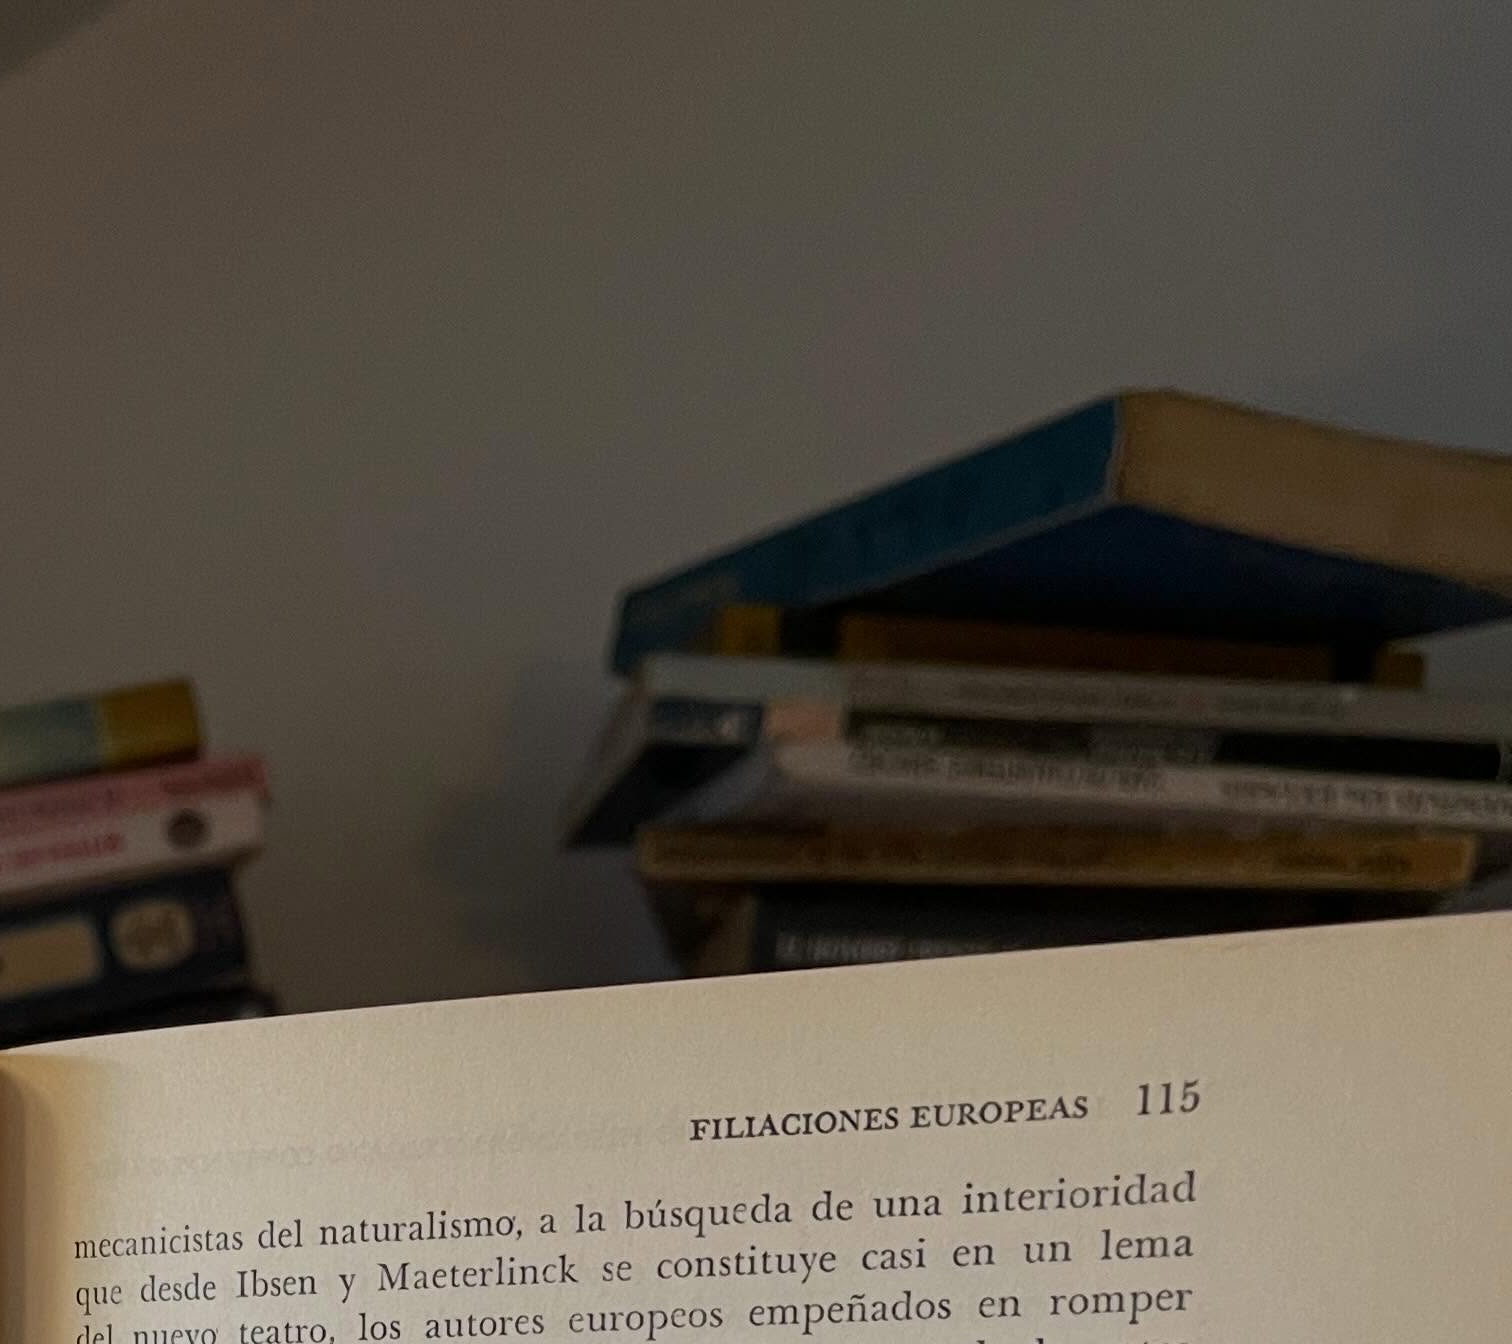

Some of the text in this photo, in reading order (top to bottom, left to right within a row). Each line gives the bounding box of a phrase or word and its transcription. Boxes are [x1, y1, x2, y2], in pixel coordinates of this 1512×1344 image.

[689, 1079, 1200, 1142] FILIACIONES EUROPEAS 115
[74, 1169, 1196, 1260] mecanicistas del naturalismo, a la búsqueda de una interioridad
